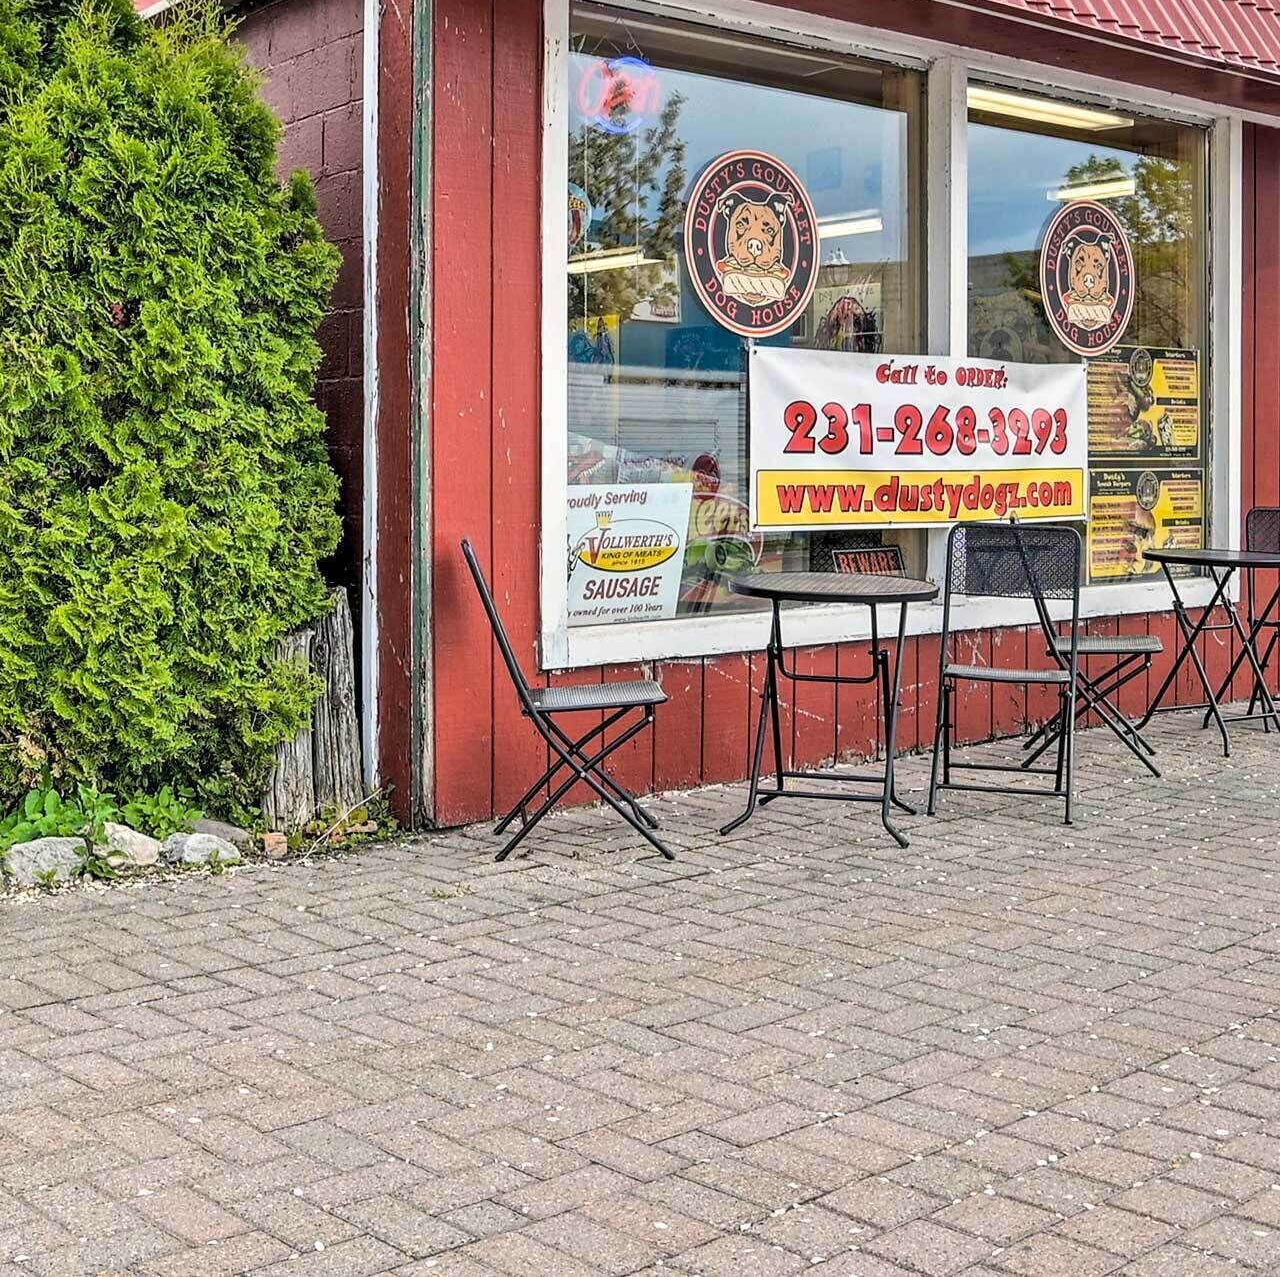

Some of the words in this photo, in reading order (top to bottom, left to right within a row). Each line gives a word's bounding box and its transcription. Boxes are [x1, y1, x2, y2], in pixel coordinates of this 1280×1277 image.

[695, 162, 745, 233] DUSTY'S
[1047, 210, 1081, 270] DUSTY'S
[704, 277, 738, 320] DOG
[751, 285, 801, 325] HOUSE
[1055, 309, 1079, 342] DOG
[1087, 311, 1122, 346] HOUSE
[876, 359, 918, 385] Call
[924, 365, 948, 385] to
[955, 364, 1009, 389] ORDER:
[782, 400, 1068, 456] 231-268-3293
[604, 490, 648, 506] Serving
[776, 475, 1072, 519] www.dustydogz.com
[585, 527, 674, 565] VOLLWERTH'S
[601, 551, 622, 560] KING
[622, 550, 634, 559] OF
[582, 576, 663, 601] SAUSAGE
[573, 606, 597, 616] owned
[596, 604, 610, 618] for
[611, 607, 628, 615] over
[629, 604, 644, 613] 100
[644, 603, 663, 612] Years
